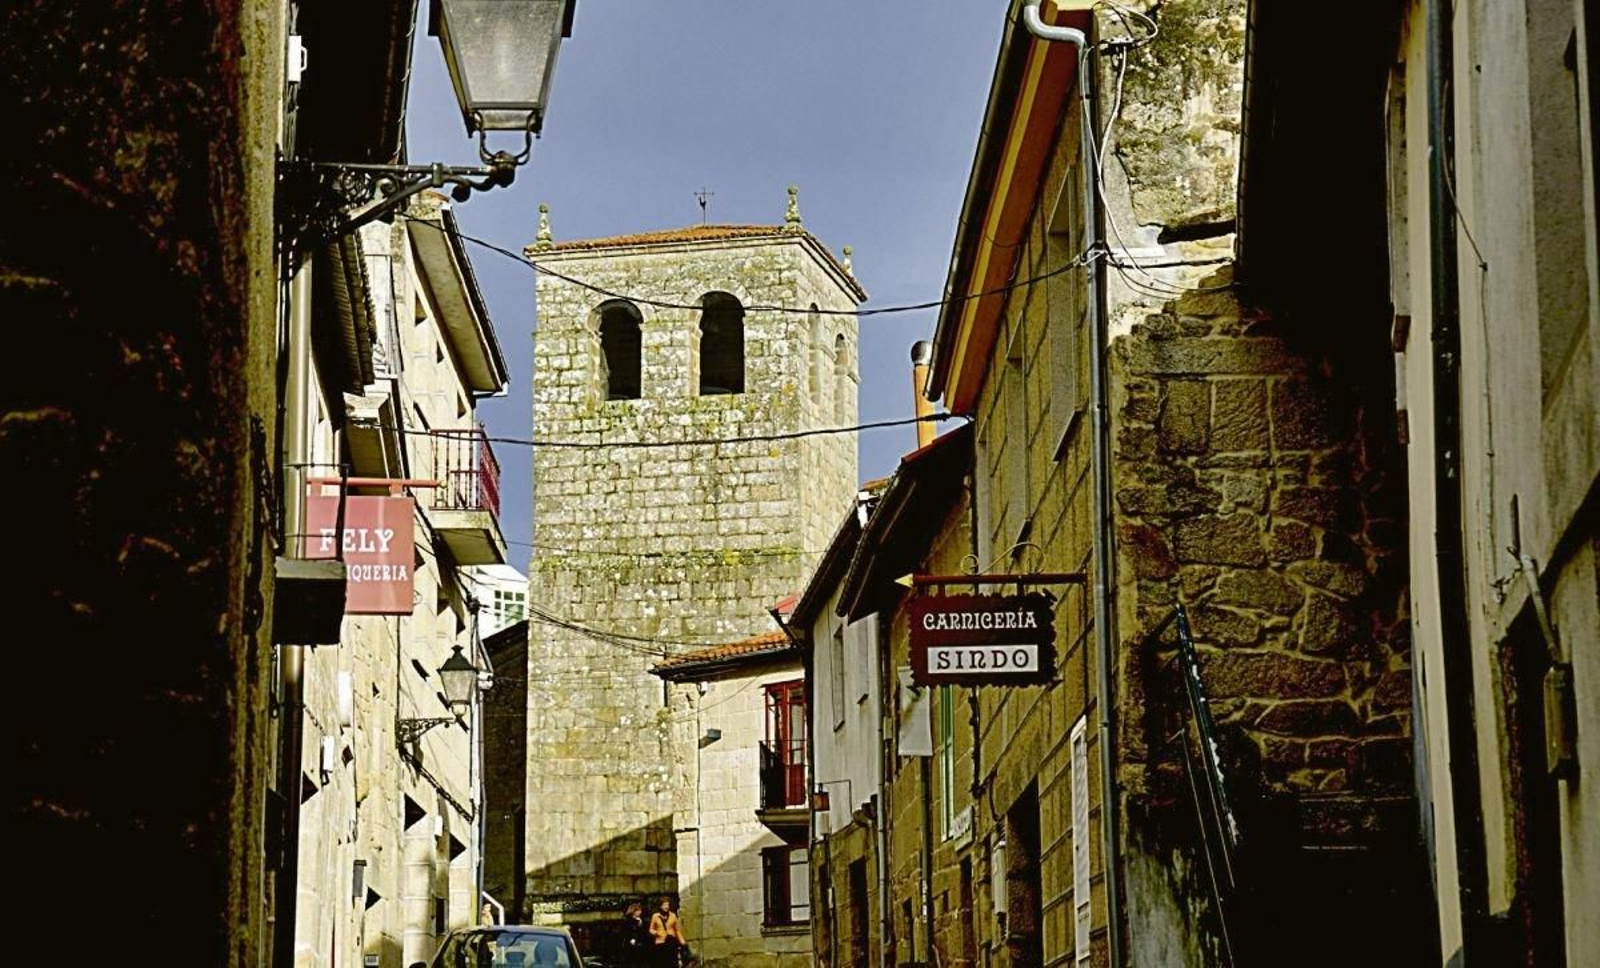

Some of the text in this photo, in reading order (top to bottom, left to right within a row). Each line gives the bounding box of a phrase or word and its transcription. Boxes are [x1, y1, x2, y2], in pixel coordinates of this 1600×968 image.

[320, 528, 394, 553] FELY
[346, 564, 408, 582] QUERIA
[923, 607, 1038, 630] CARNICERÍA
[936, 649, 1030, 670] SINDO
